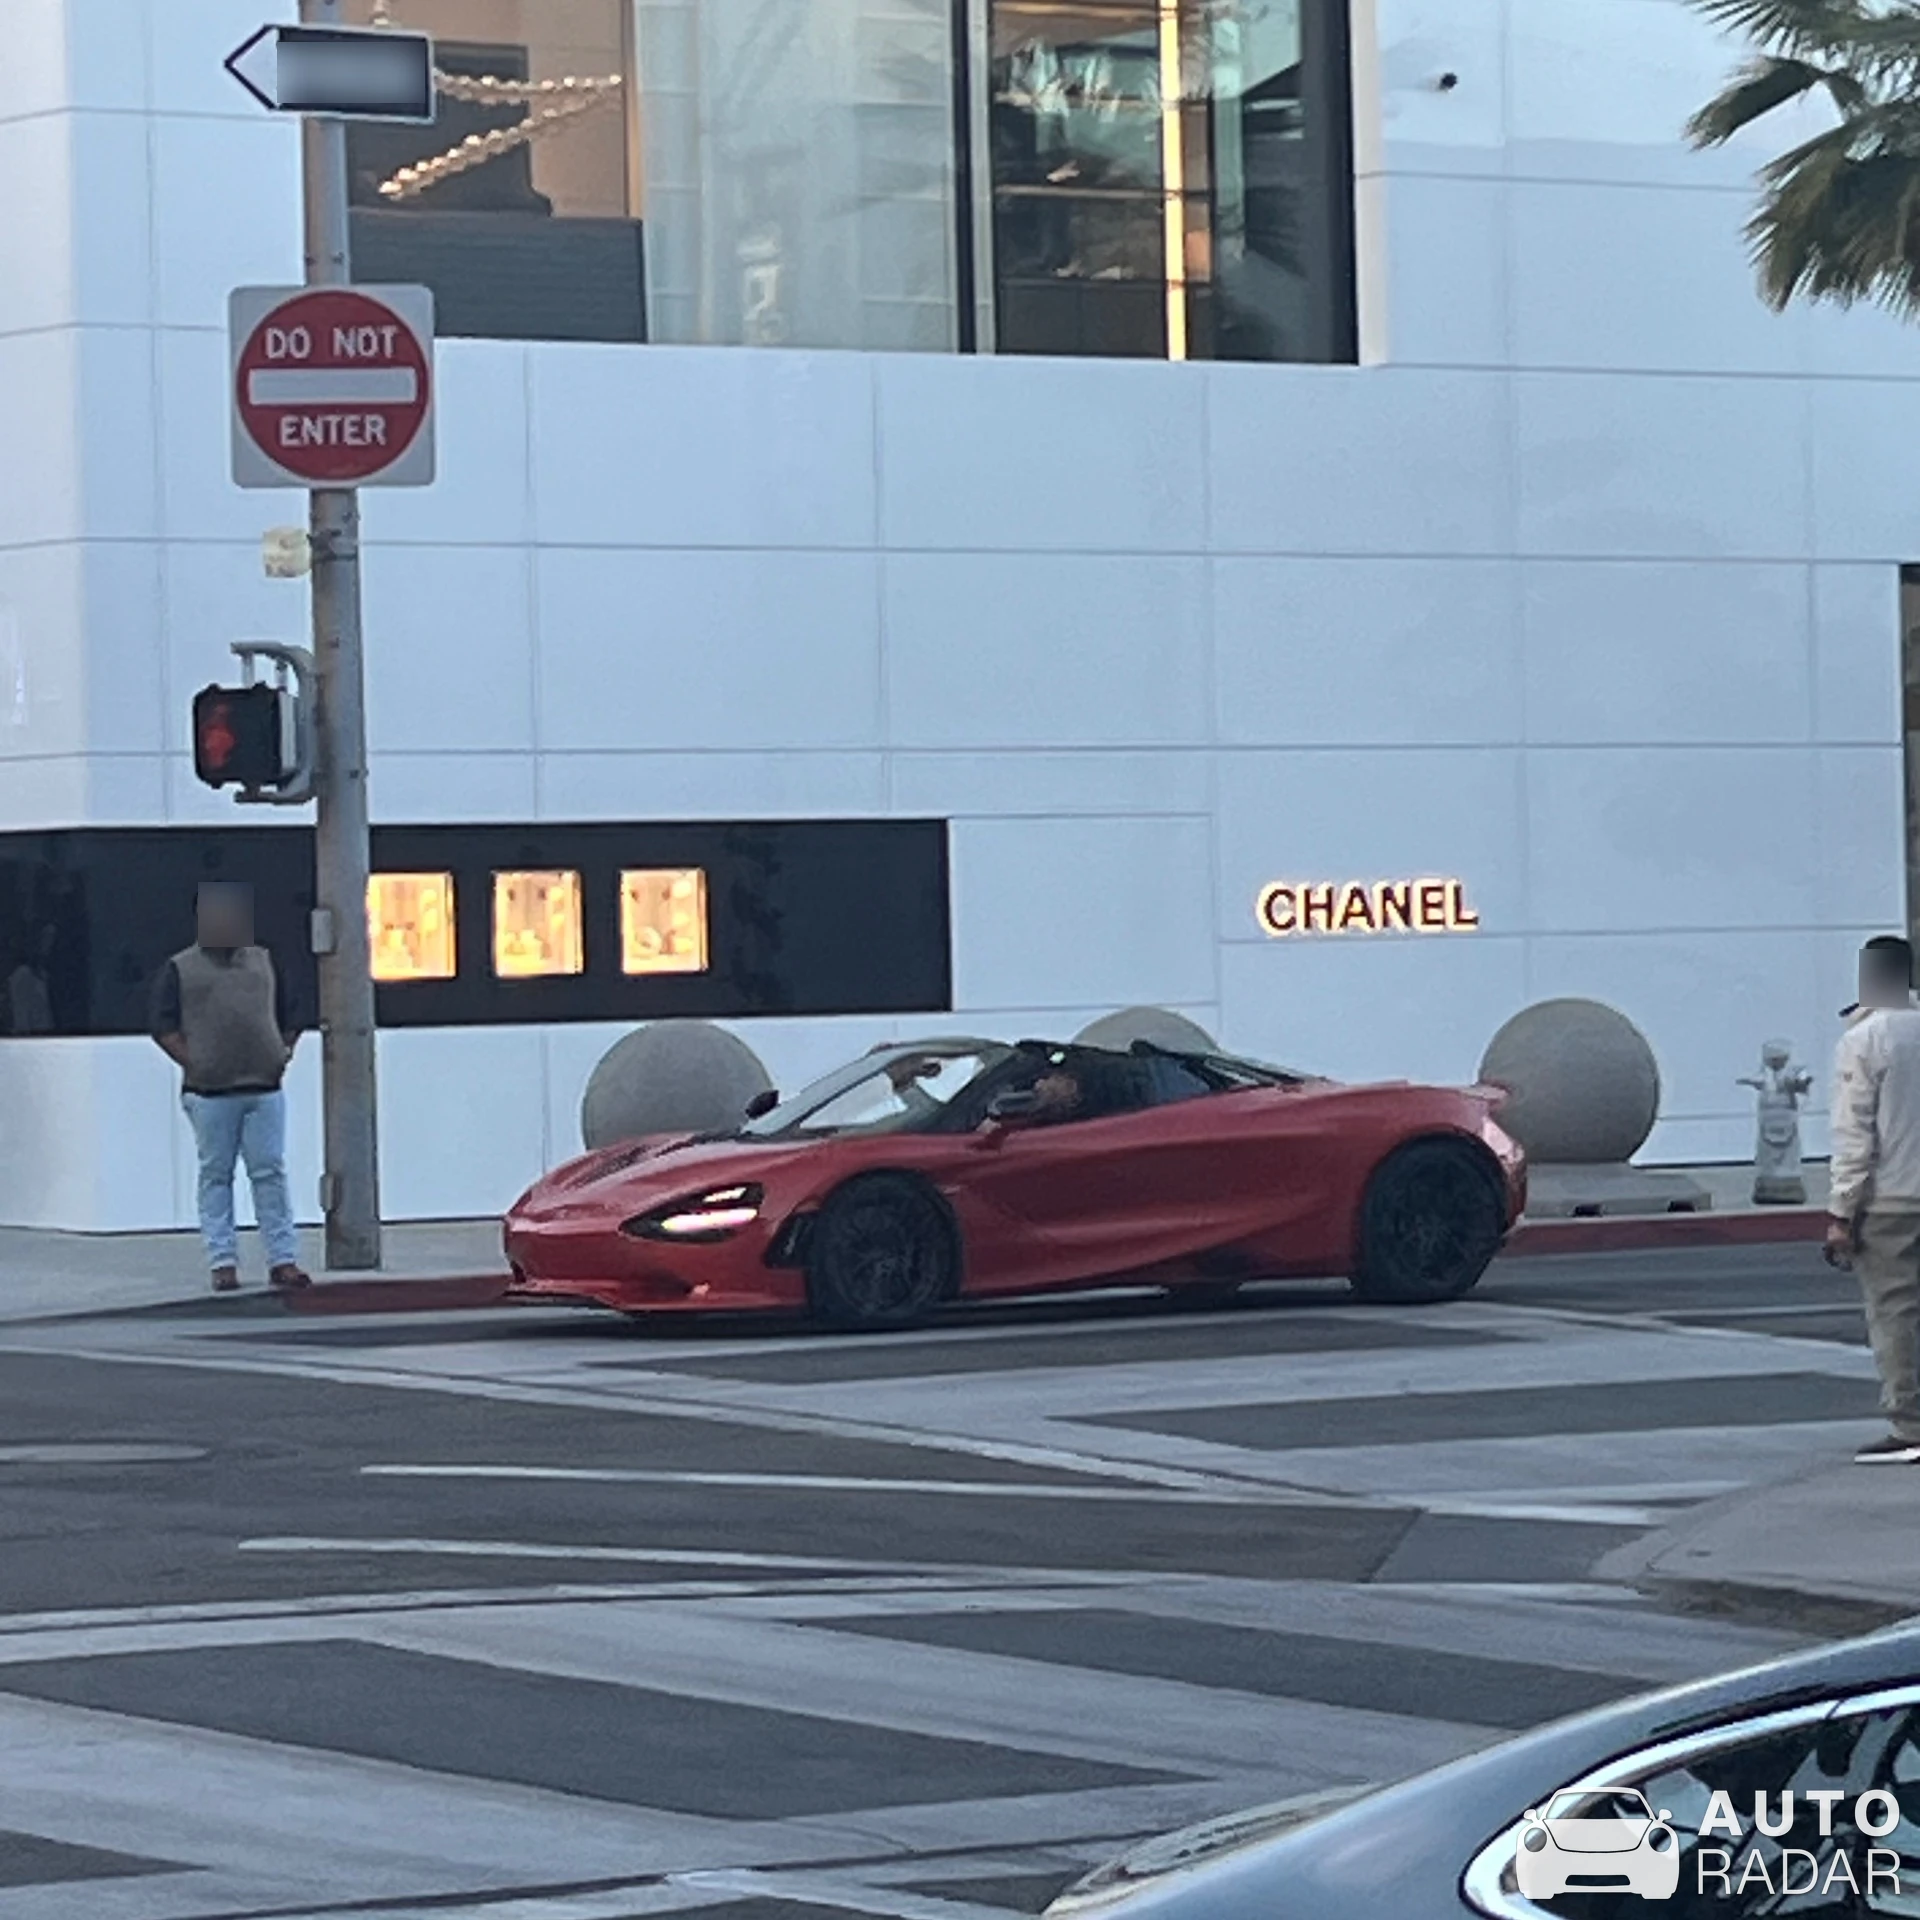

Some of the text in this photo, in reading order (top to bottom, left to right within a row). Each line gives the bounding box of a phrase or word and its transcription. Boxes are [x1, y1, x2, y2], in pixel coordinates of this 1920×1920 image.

[264, 325, 398, 359] DO NOT
[279, 414, 386, 447] ENTER
[1260, 881, 1479, 933] CHANEL
